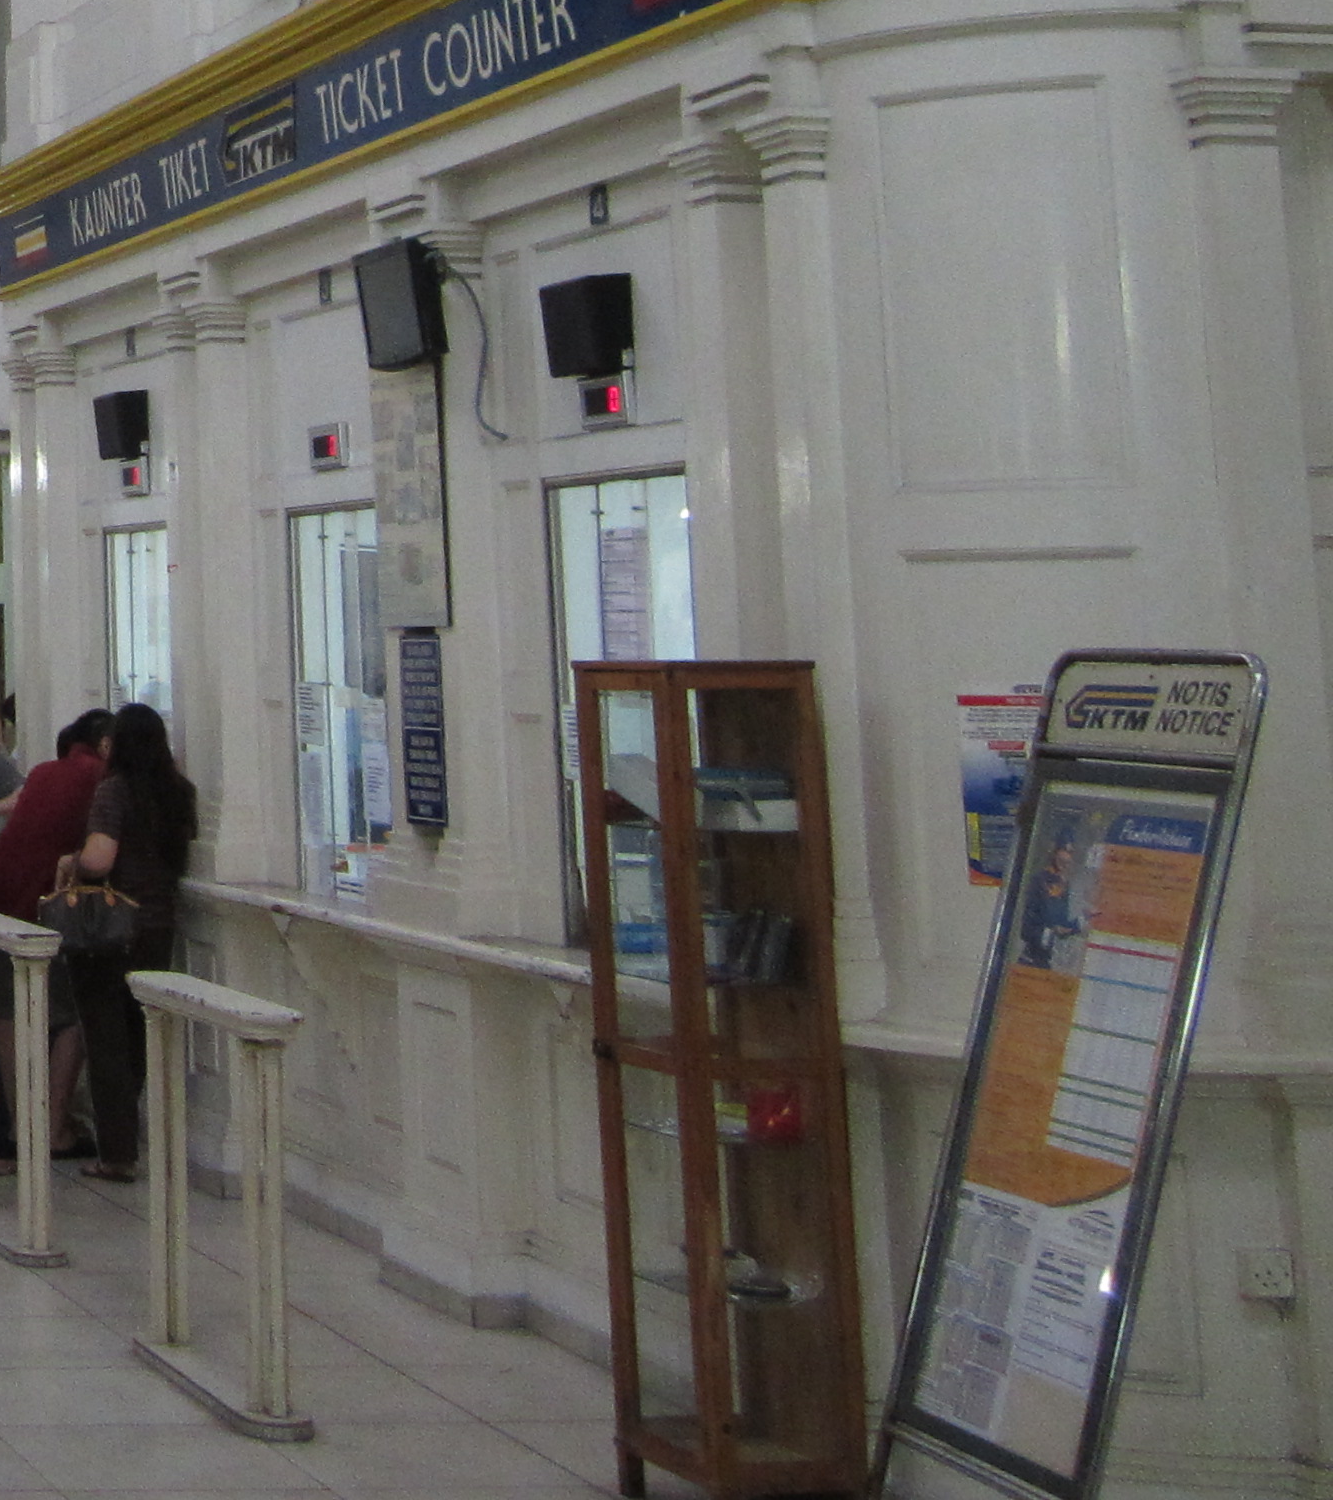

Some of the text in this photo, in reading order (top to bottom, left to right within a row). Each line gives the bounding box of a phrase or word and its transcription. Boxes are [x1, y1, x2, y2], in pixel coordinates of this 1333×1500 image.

[315, 48, 404, 144] TICKET
[69, 137, 210, 246] KAUNTER TIKET
[1087, 706, 1236, 737] KTM NOTICE
[1167, 680, 1232, 706] NOTIS
